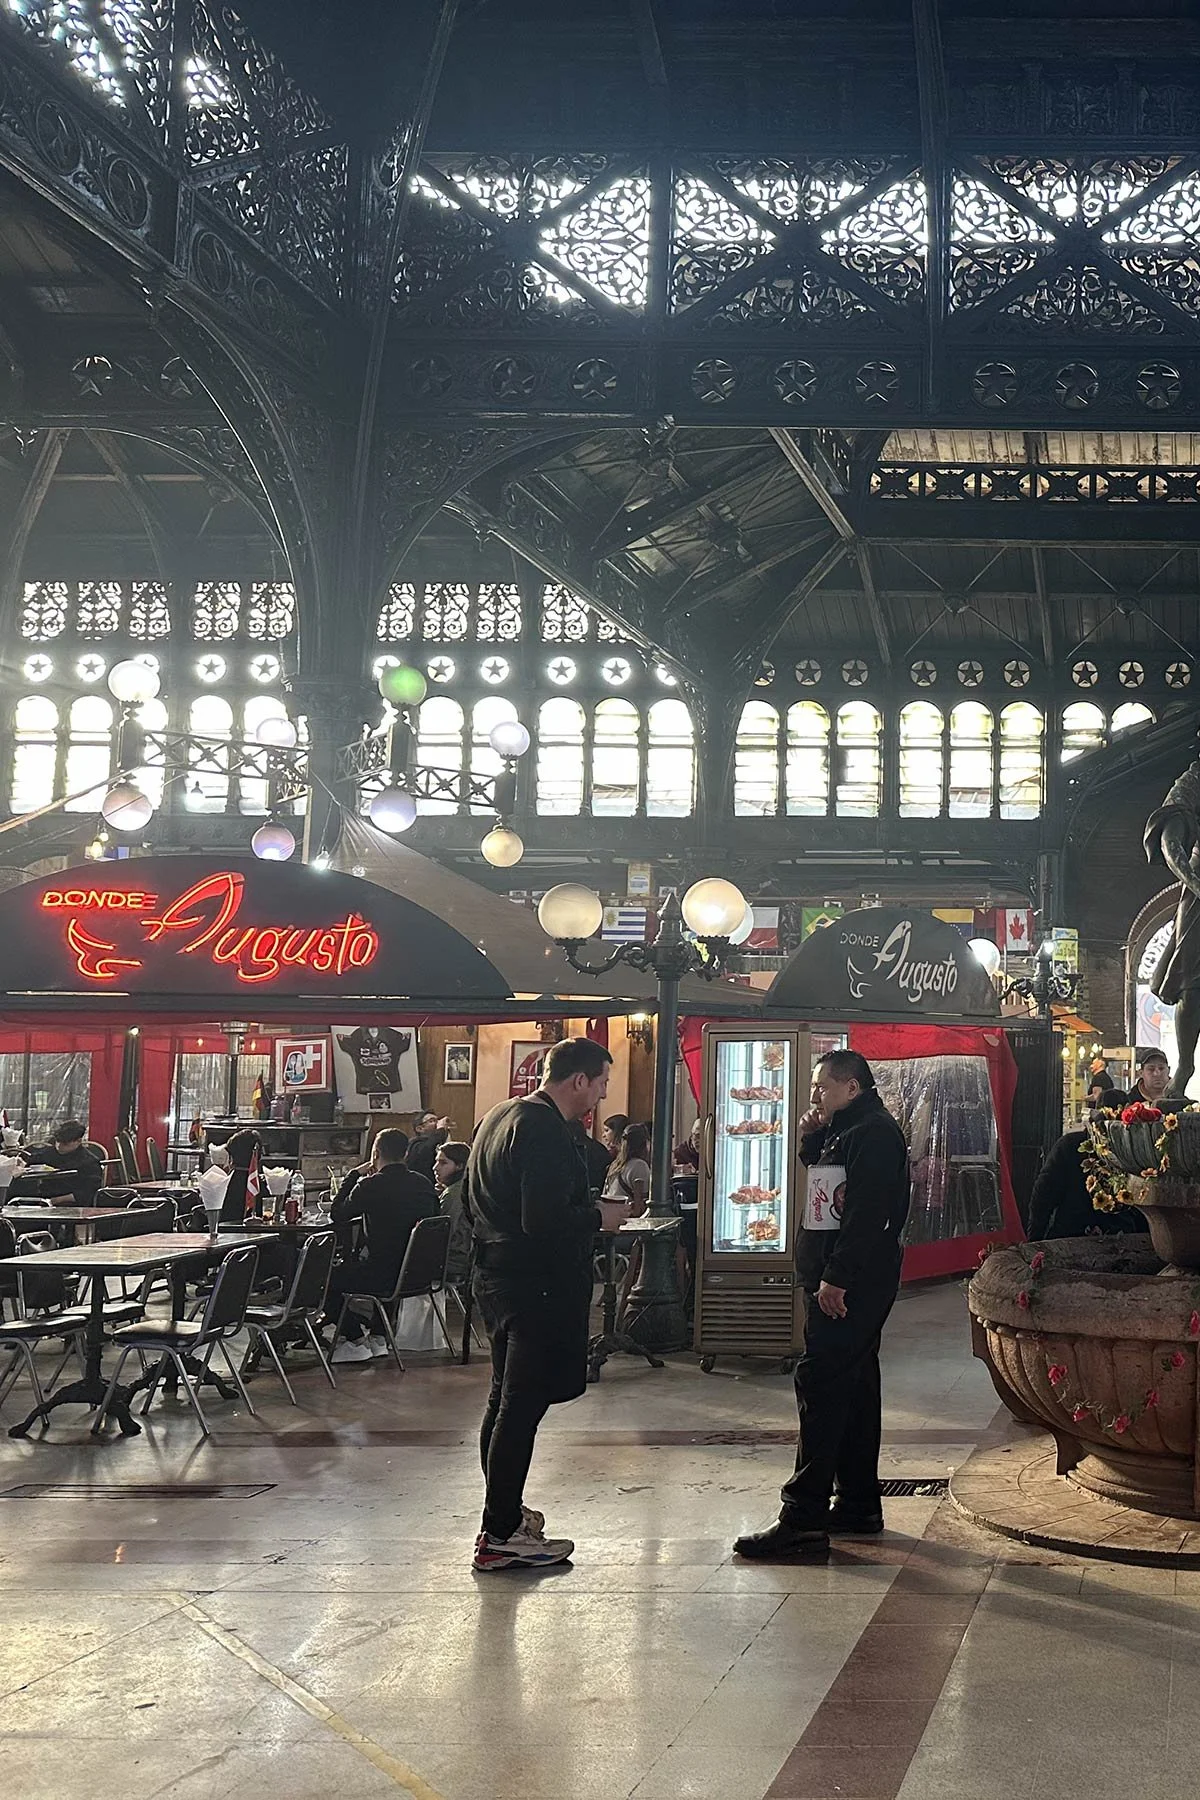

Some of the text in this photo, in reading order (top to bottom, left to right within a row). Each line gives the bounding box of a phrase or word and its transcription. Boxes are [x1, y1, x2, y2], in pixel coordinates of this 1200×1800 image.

[42, 890, 158, 910] DONDE
[140, 871, 379, 983] Augusto
[840, 932, 880, 947] DONDE
[872, 920, 958, 1002] Augusto
